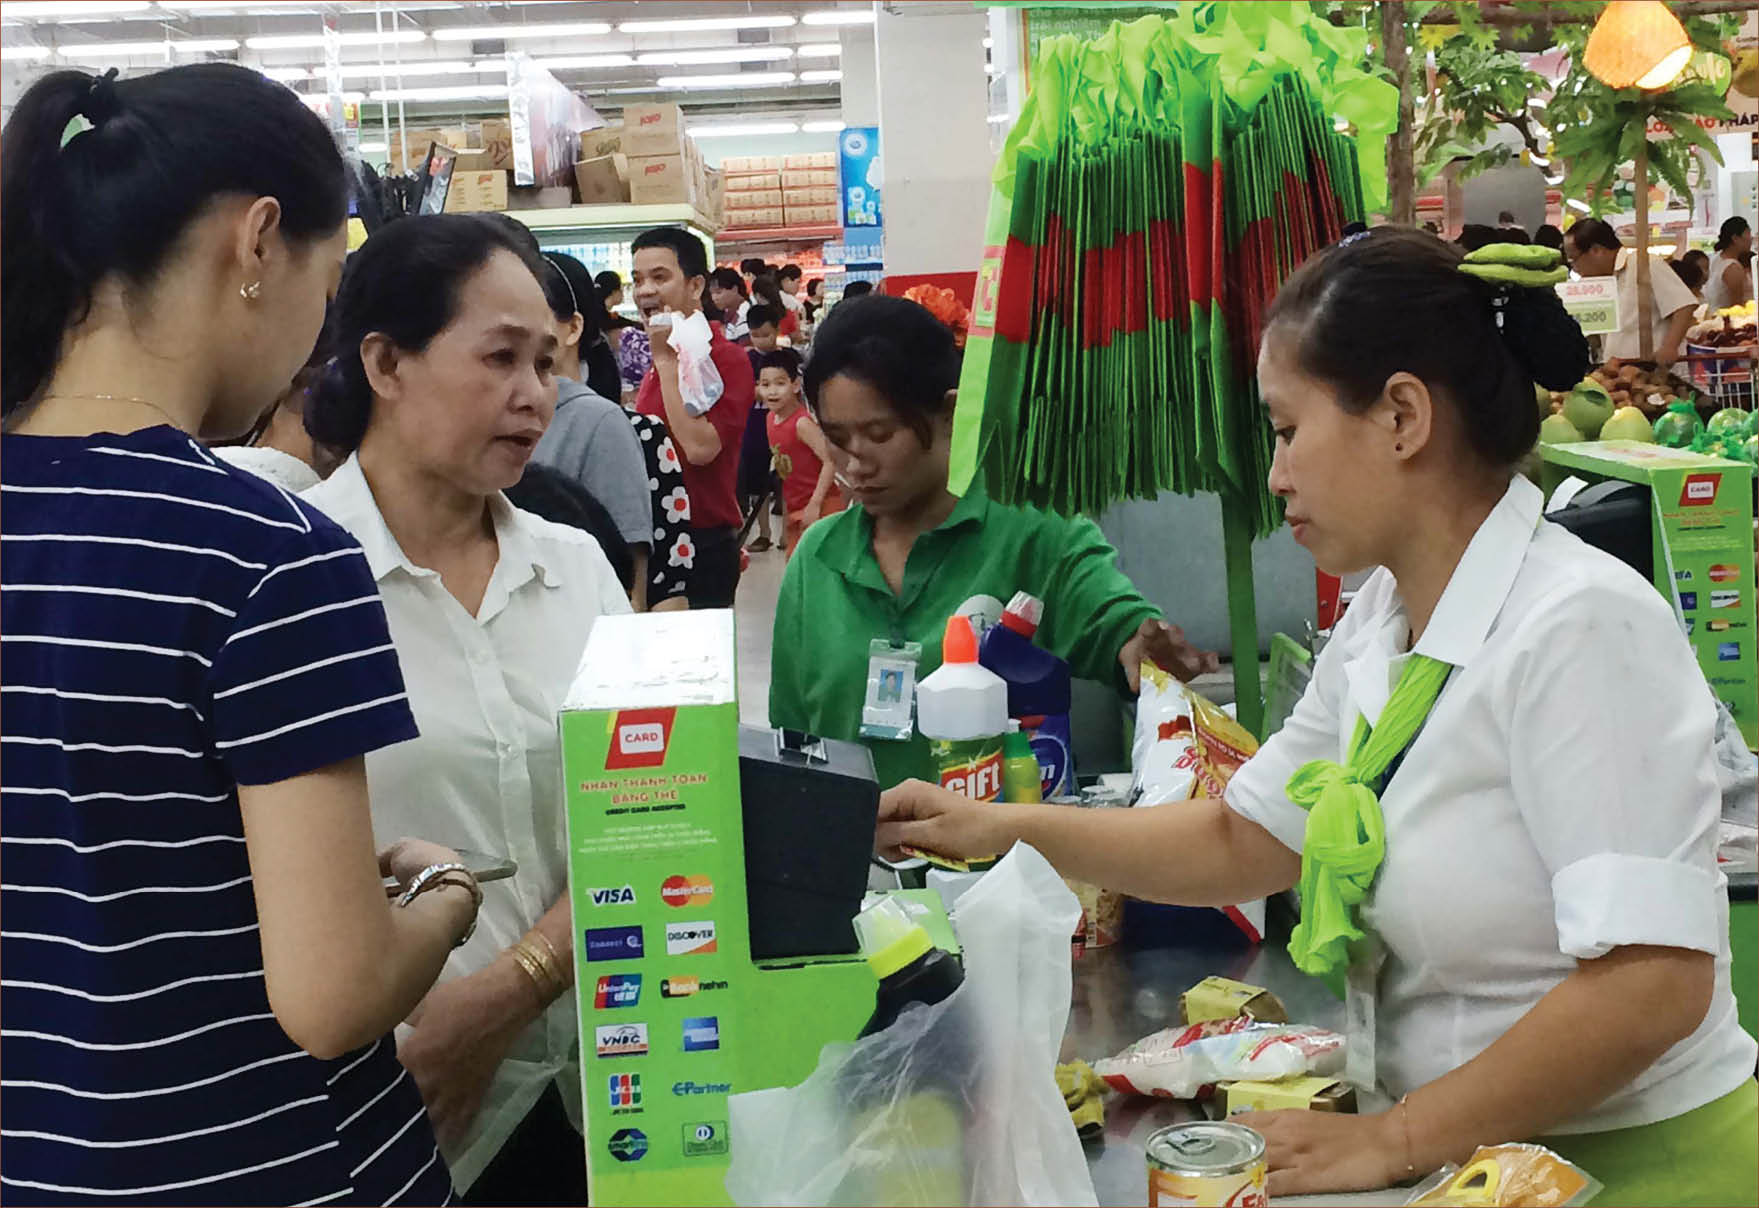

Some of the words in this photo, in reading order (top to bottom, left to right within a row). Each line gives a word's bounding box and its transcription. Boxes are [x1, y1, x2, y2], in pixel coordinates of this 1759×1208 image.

[624, 732, 658, 743] CARD
[592, 888, 634, 904] VISA
[668, 930, 713, 941] DISCOVER
[598, 982, 640, 994] UnionPay
